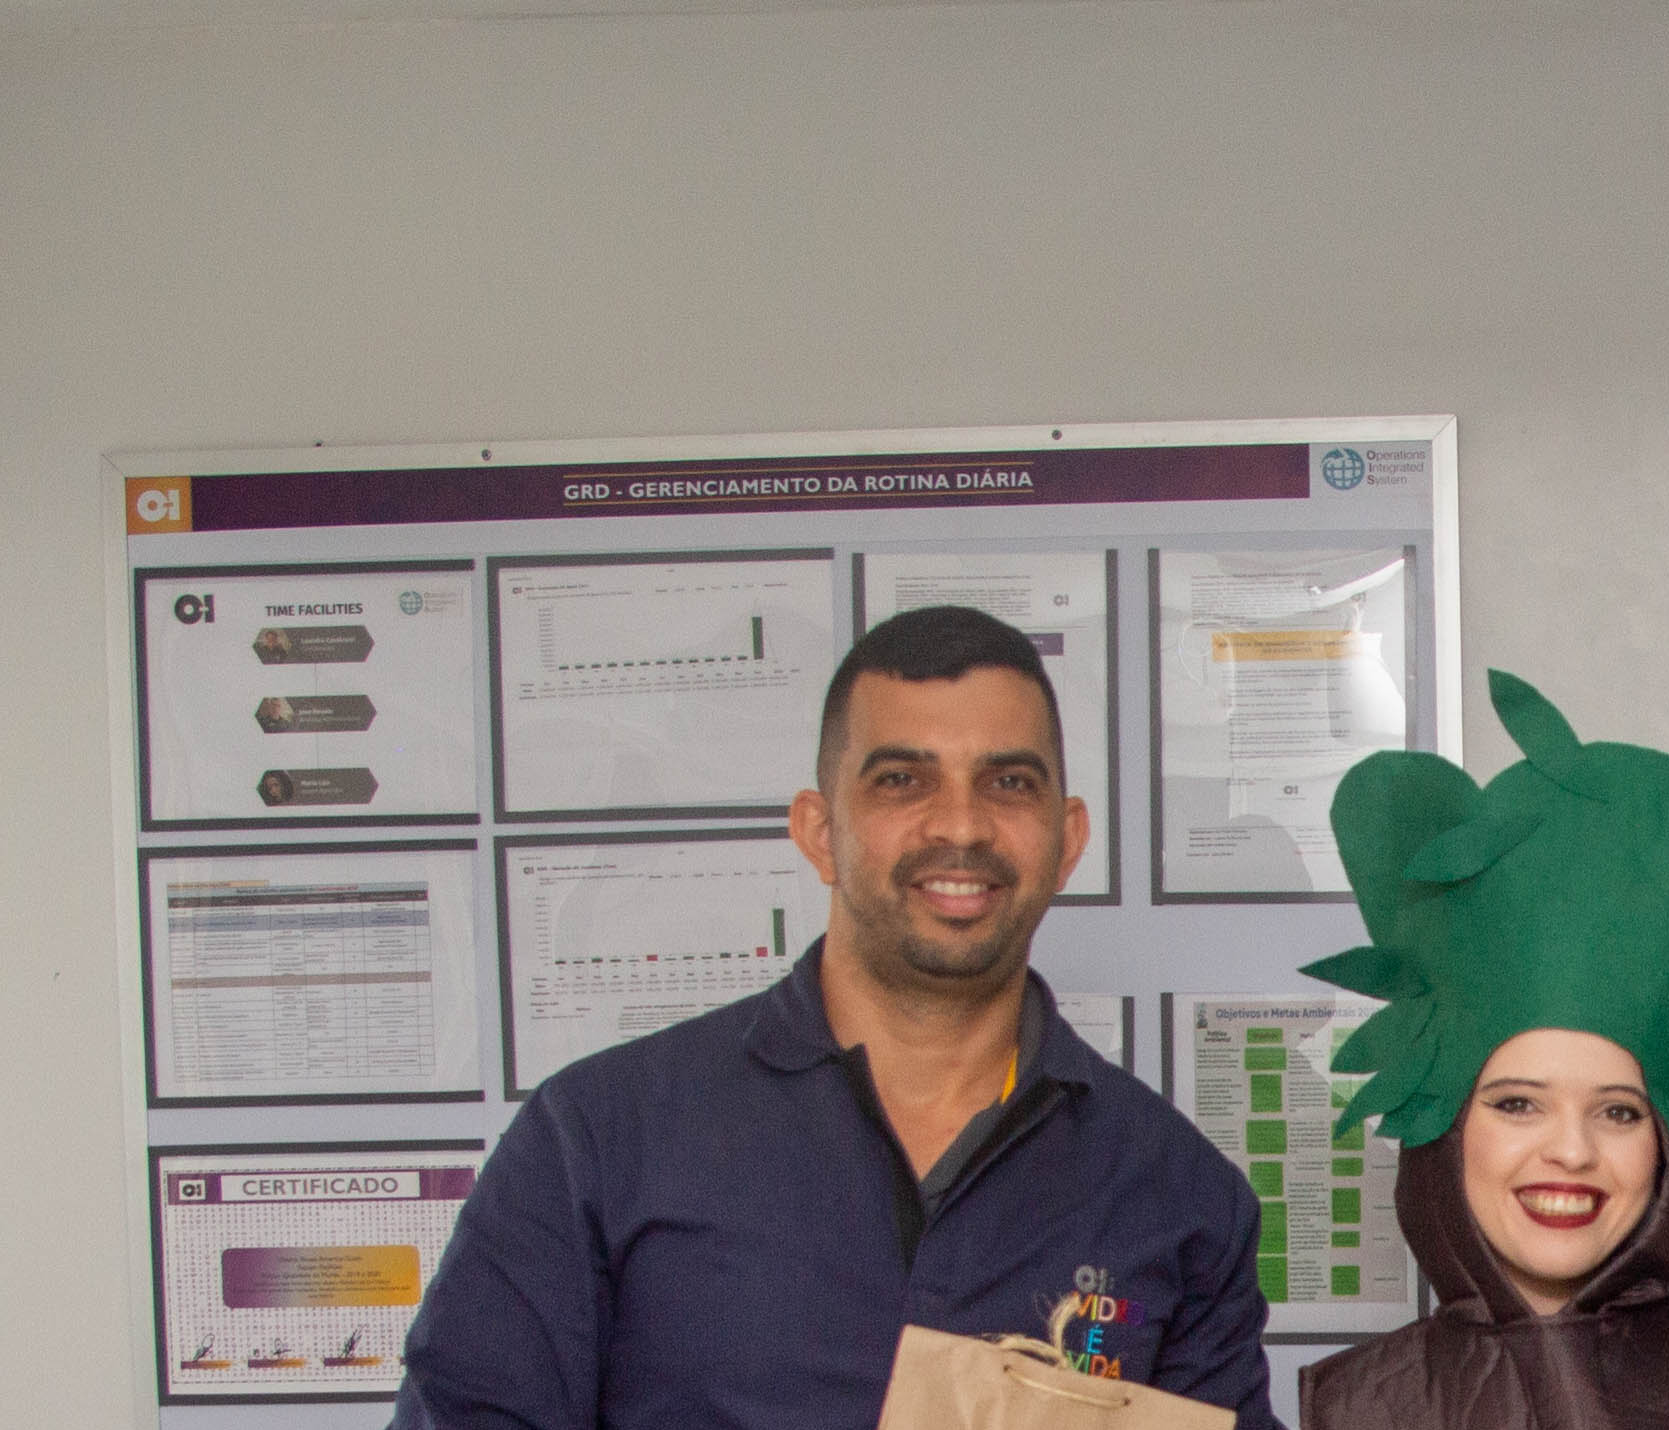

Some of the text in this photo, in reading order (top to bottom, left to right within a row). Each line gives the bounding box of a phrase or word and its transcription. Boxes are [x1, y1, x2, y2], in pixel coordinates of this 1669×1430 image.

[1366, 450, 1426, 462] Operations
[1368, 463, 1424, 473] Integrated
[564, 484, 611, 501] GRD
[628, 477, 822, 499] GERENCIAMENTO
[828, 476, 859, 493] DA
[864, 473, 951, 492] ROTINA
[956, 468, 1034, 490] DIÁRIA
[1366, 474, 1408, 486] System
[265, 602, 364, 617] TIME FACILITIES
[1215, 1007, 1261, 1022] Objetivos
[1263, 1010, 1269, 1018] e
[1270, 1007, 1300, 1018] Metas
[1302, 1006, 1357, 1019] Ambientais
[242, 1175, 399, 1197] CERTIFICADO
[1087, 1323, 1105, 1354] É
